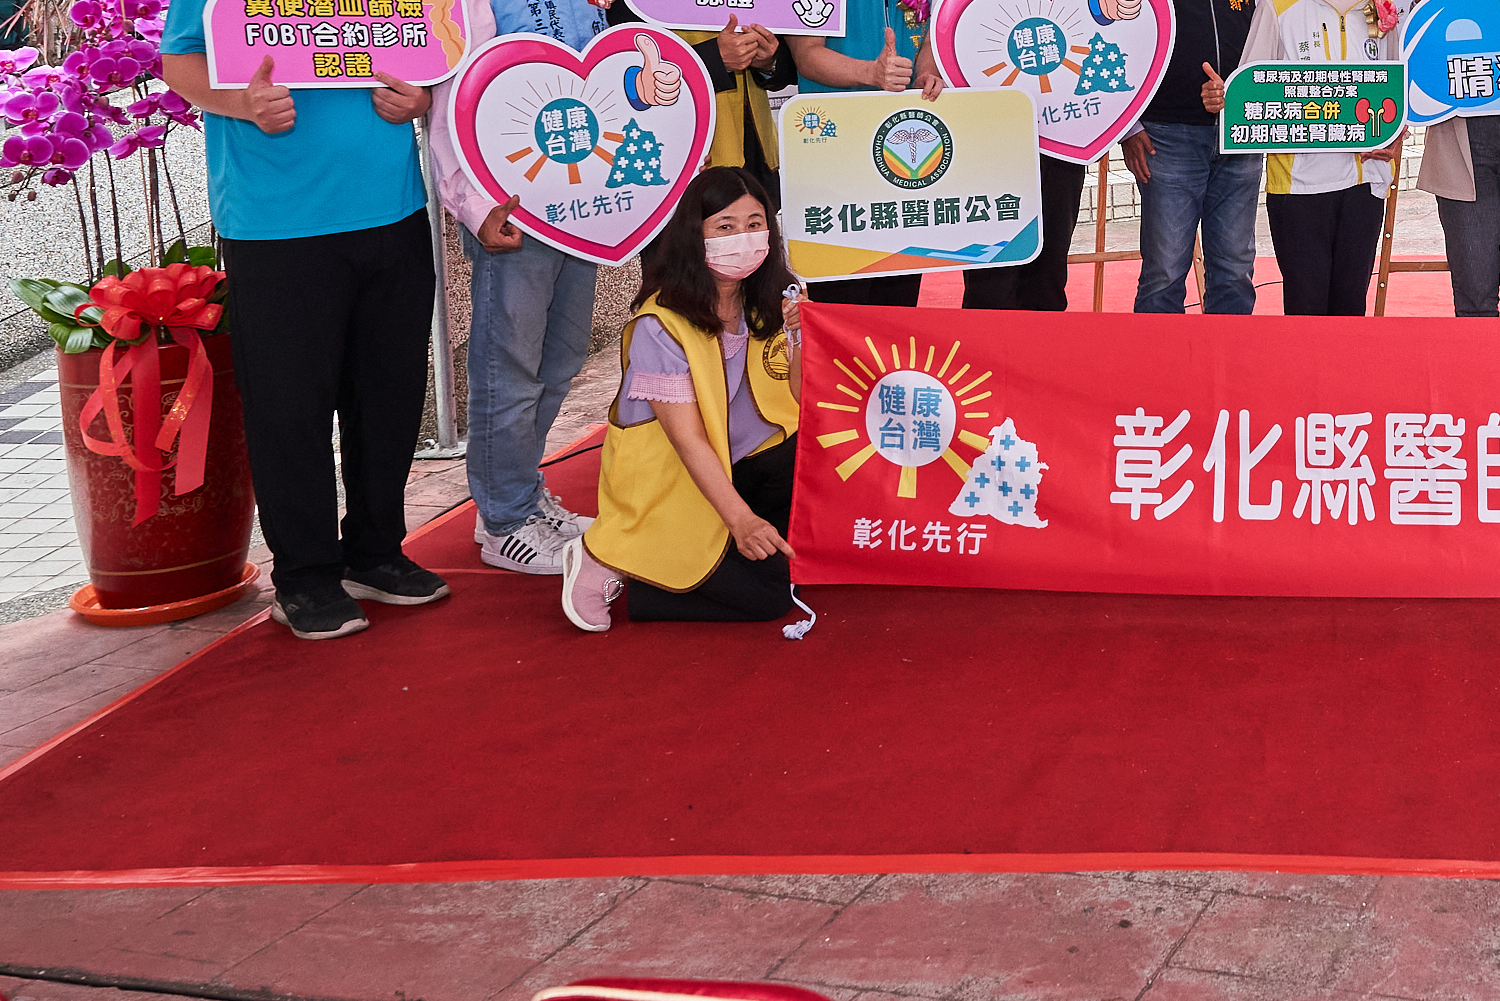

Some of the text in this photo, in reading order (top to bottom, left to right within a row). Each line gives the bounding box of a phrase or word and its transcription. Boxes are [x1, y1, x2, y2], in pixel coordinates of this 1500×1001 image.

[1012, 24, 1057, 49] 健康
[313, 52, 373, 78] 認證
[1017, 45, 1061, 70] 台灣
[1252, 70, 1389, 84] 糖尿病及初期慢性腎臟病
[1283, 85, 1358, 99] 照護整合方案
[541, 106, 589, 133] 健康
[1038, 97, 1102, 125] 化先行
[1244, 100, 1341, 122] 糖尿病合併
[544, 129, 593, 157] 台灣
[1230, 123, 1366, 144] 初期慢性腎臟病
[876, 132, 951, 188] CHANGHUA MEDICAL ASSOCIATION
[545, 190, 634, 225] 彰化先行
[804, 193, 1022, 235] 彰化縣醫師公會
[878, 383, 943, 418] 健康
[878, 417, 942, 452] 台灣
[852, 517, 988, 555] 彰化先行
